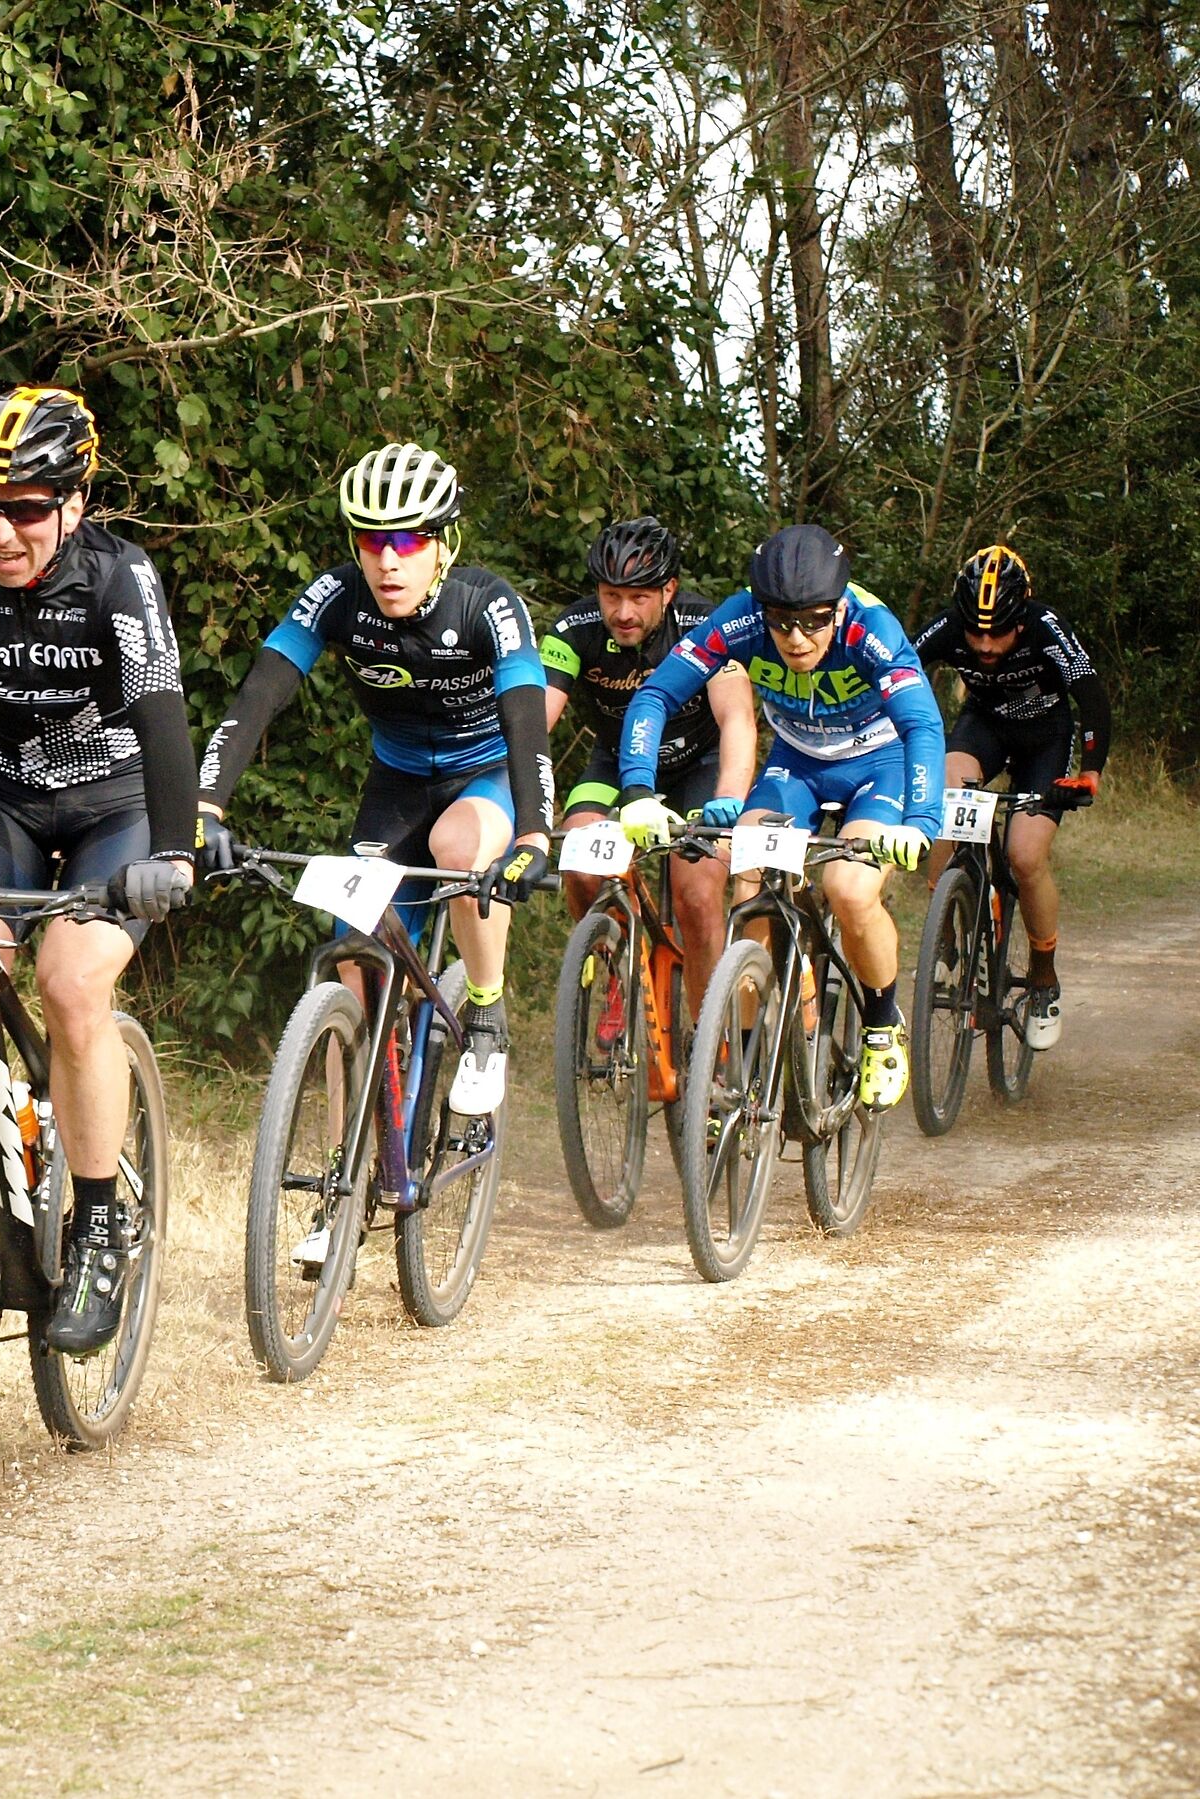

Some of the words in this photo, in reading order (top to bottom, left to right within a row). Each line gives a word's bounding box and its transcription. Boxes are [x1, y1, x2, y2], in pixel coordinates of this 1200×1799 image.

[749, 656, 872, 705] BIKE
[955, 806, 977, 828] 84
[589, 839, 615, 860] 43
[765, 833, 778, 851] 5
[343, 874, 362, 898] 4
